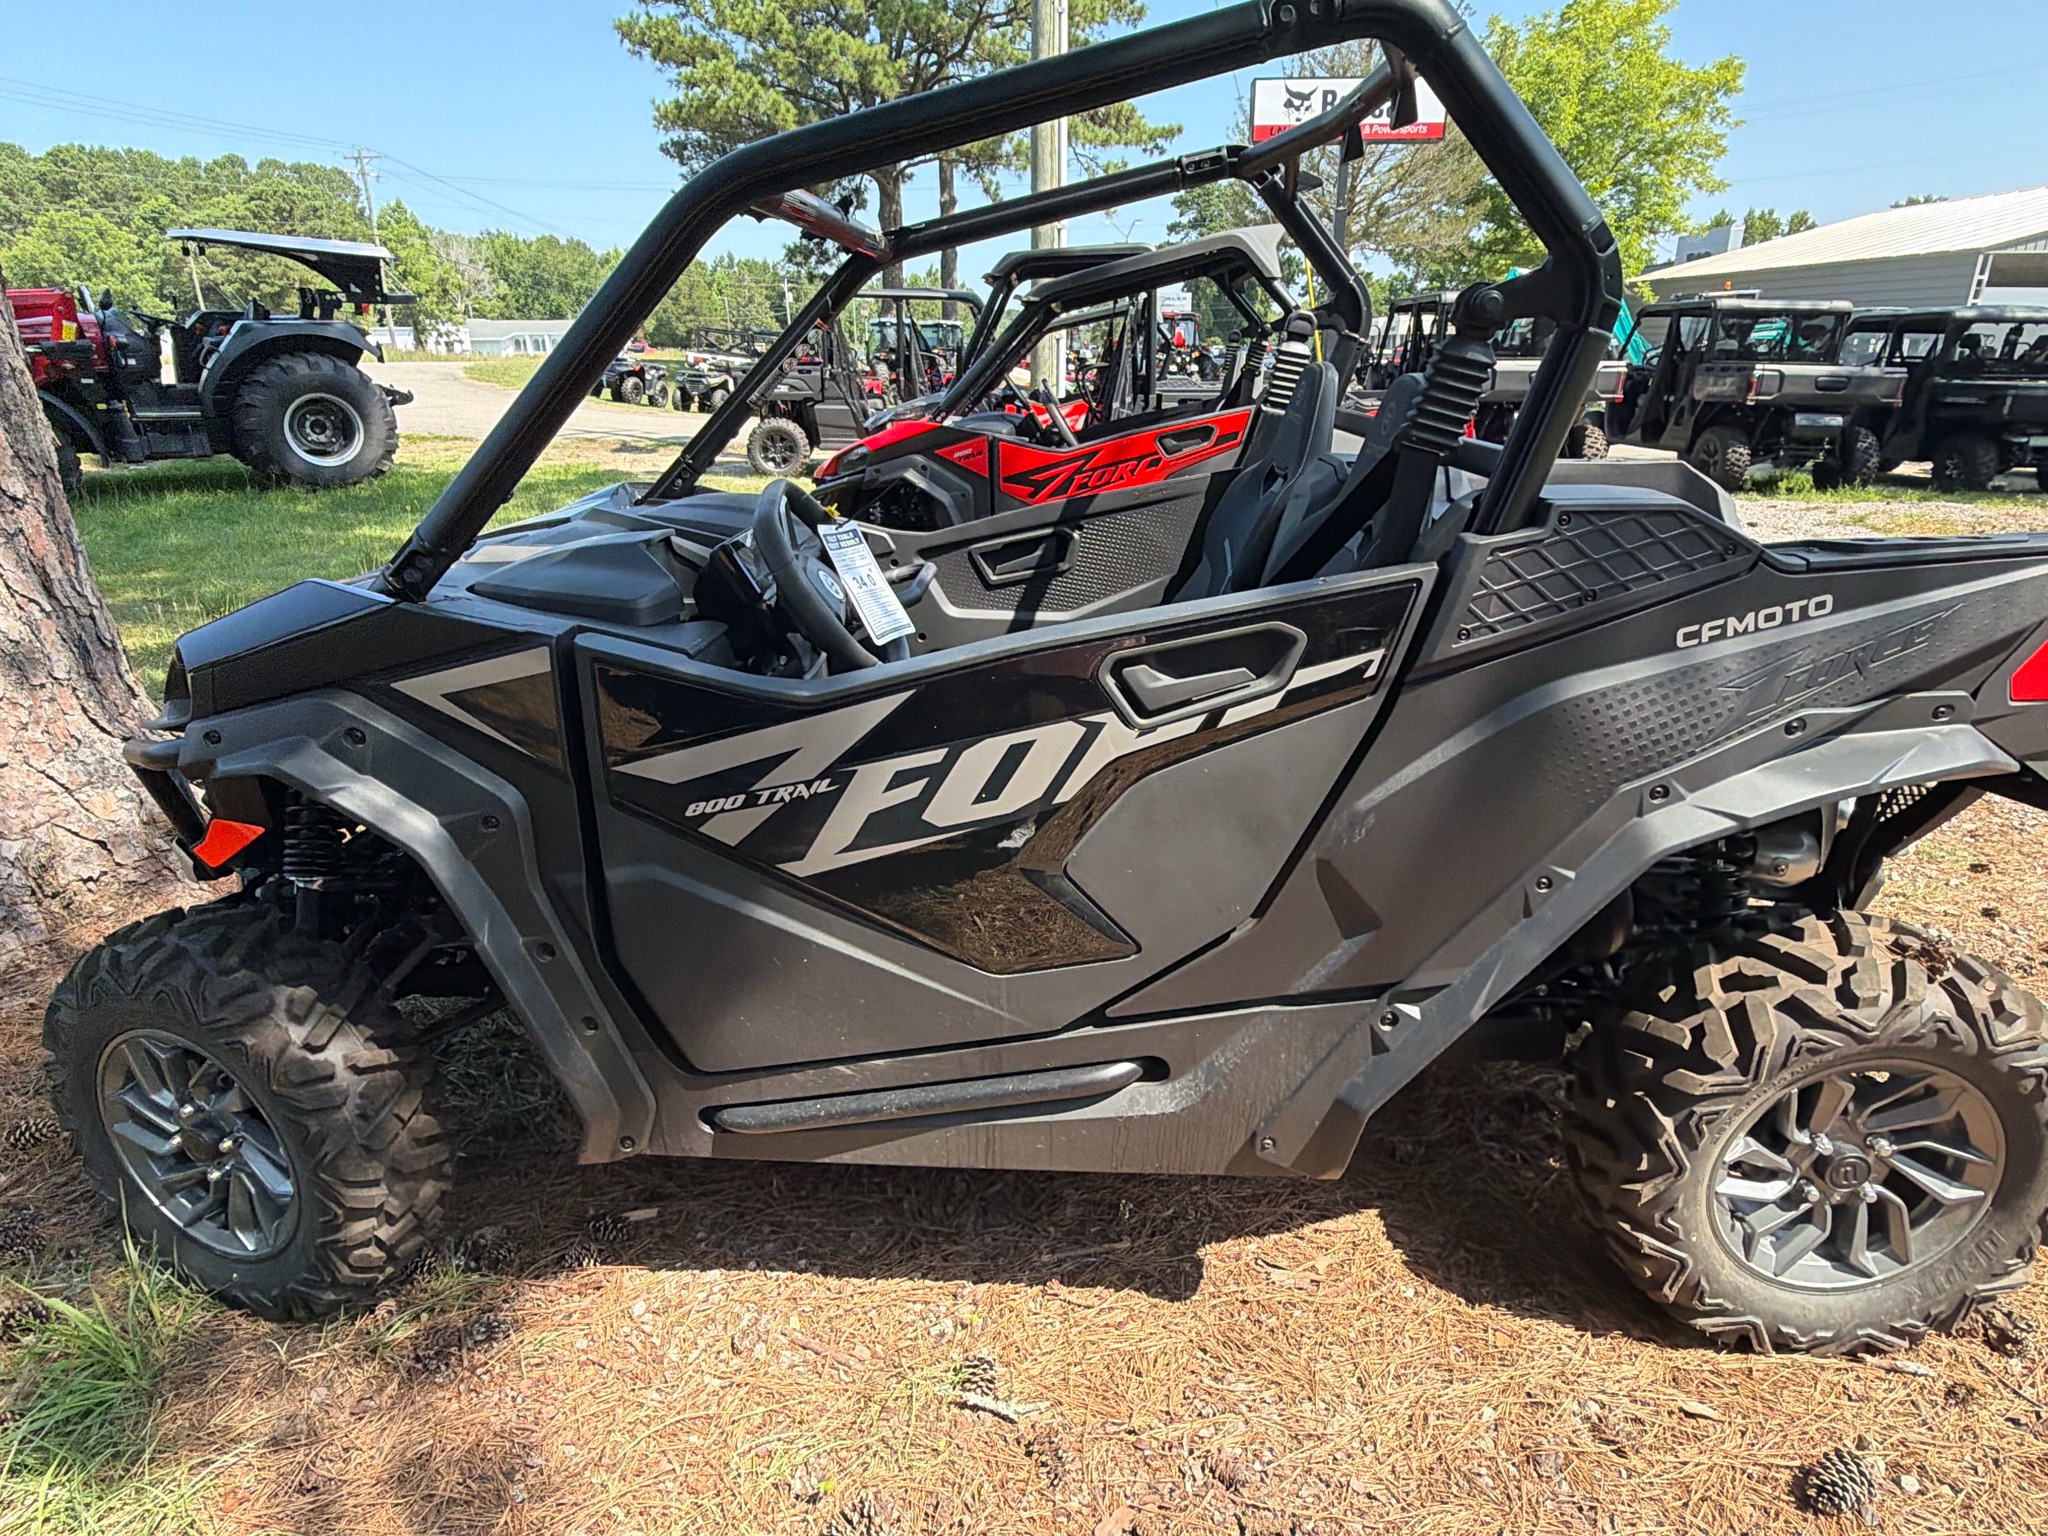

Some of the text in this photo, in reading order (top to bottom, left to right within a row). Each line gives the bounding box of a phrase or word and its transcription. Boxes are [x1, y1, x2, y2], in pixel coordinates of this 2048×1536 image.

[1676, 594, 1834, 649] CFMOTO
[684, 778, 841, 818] 800 TRAIL
